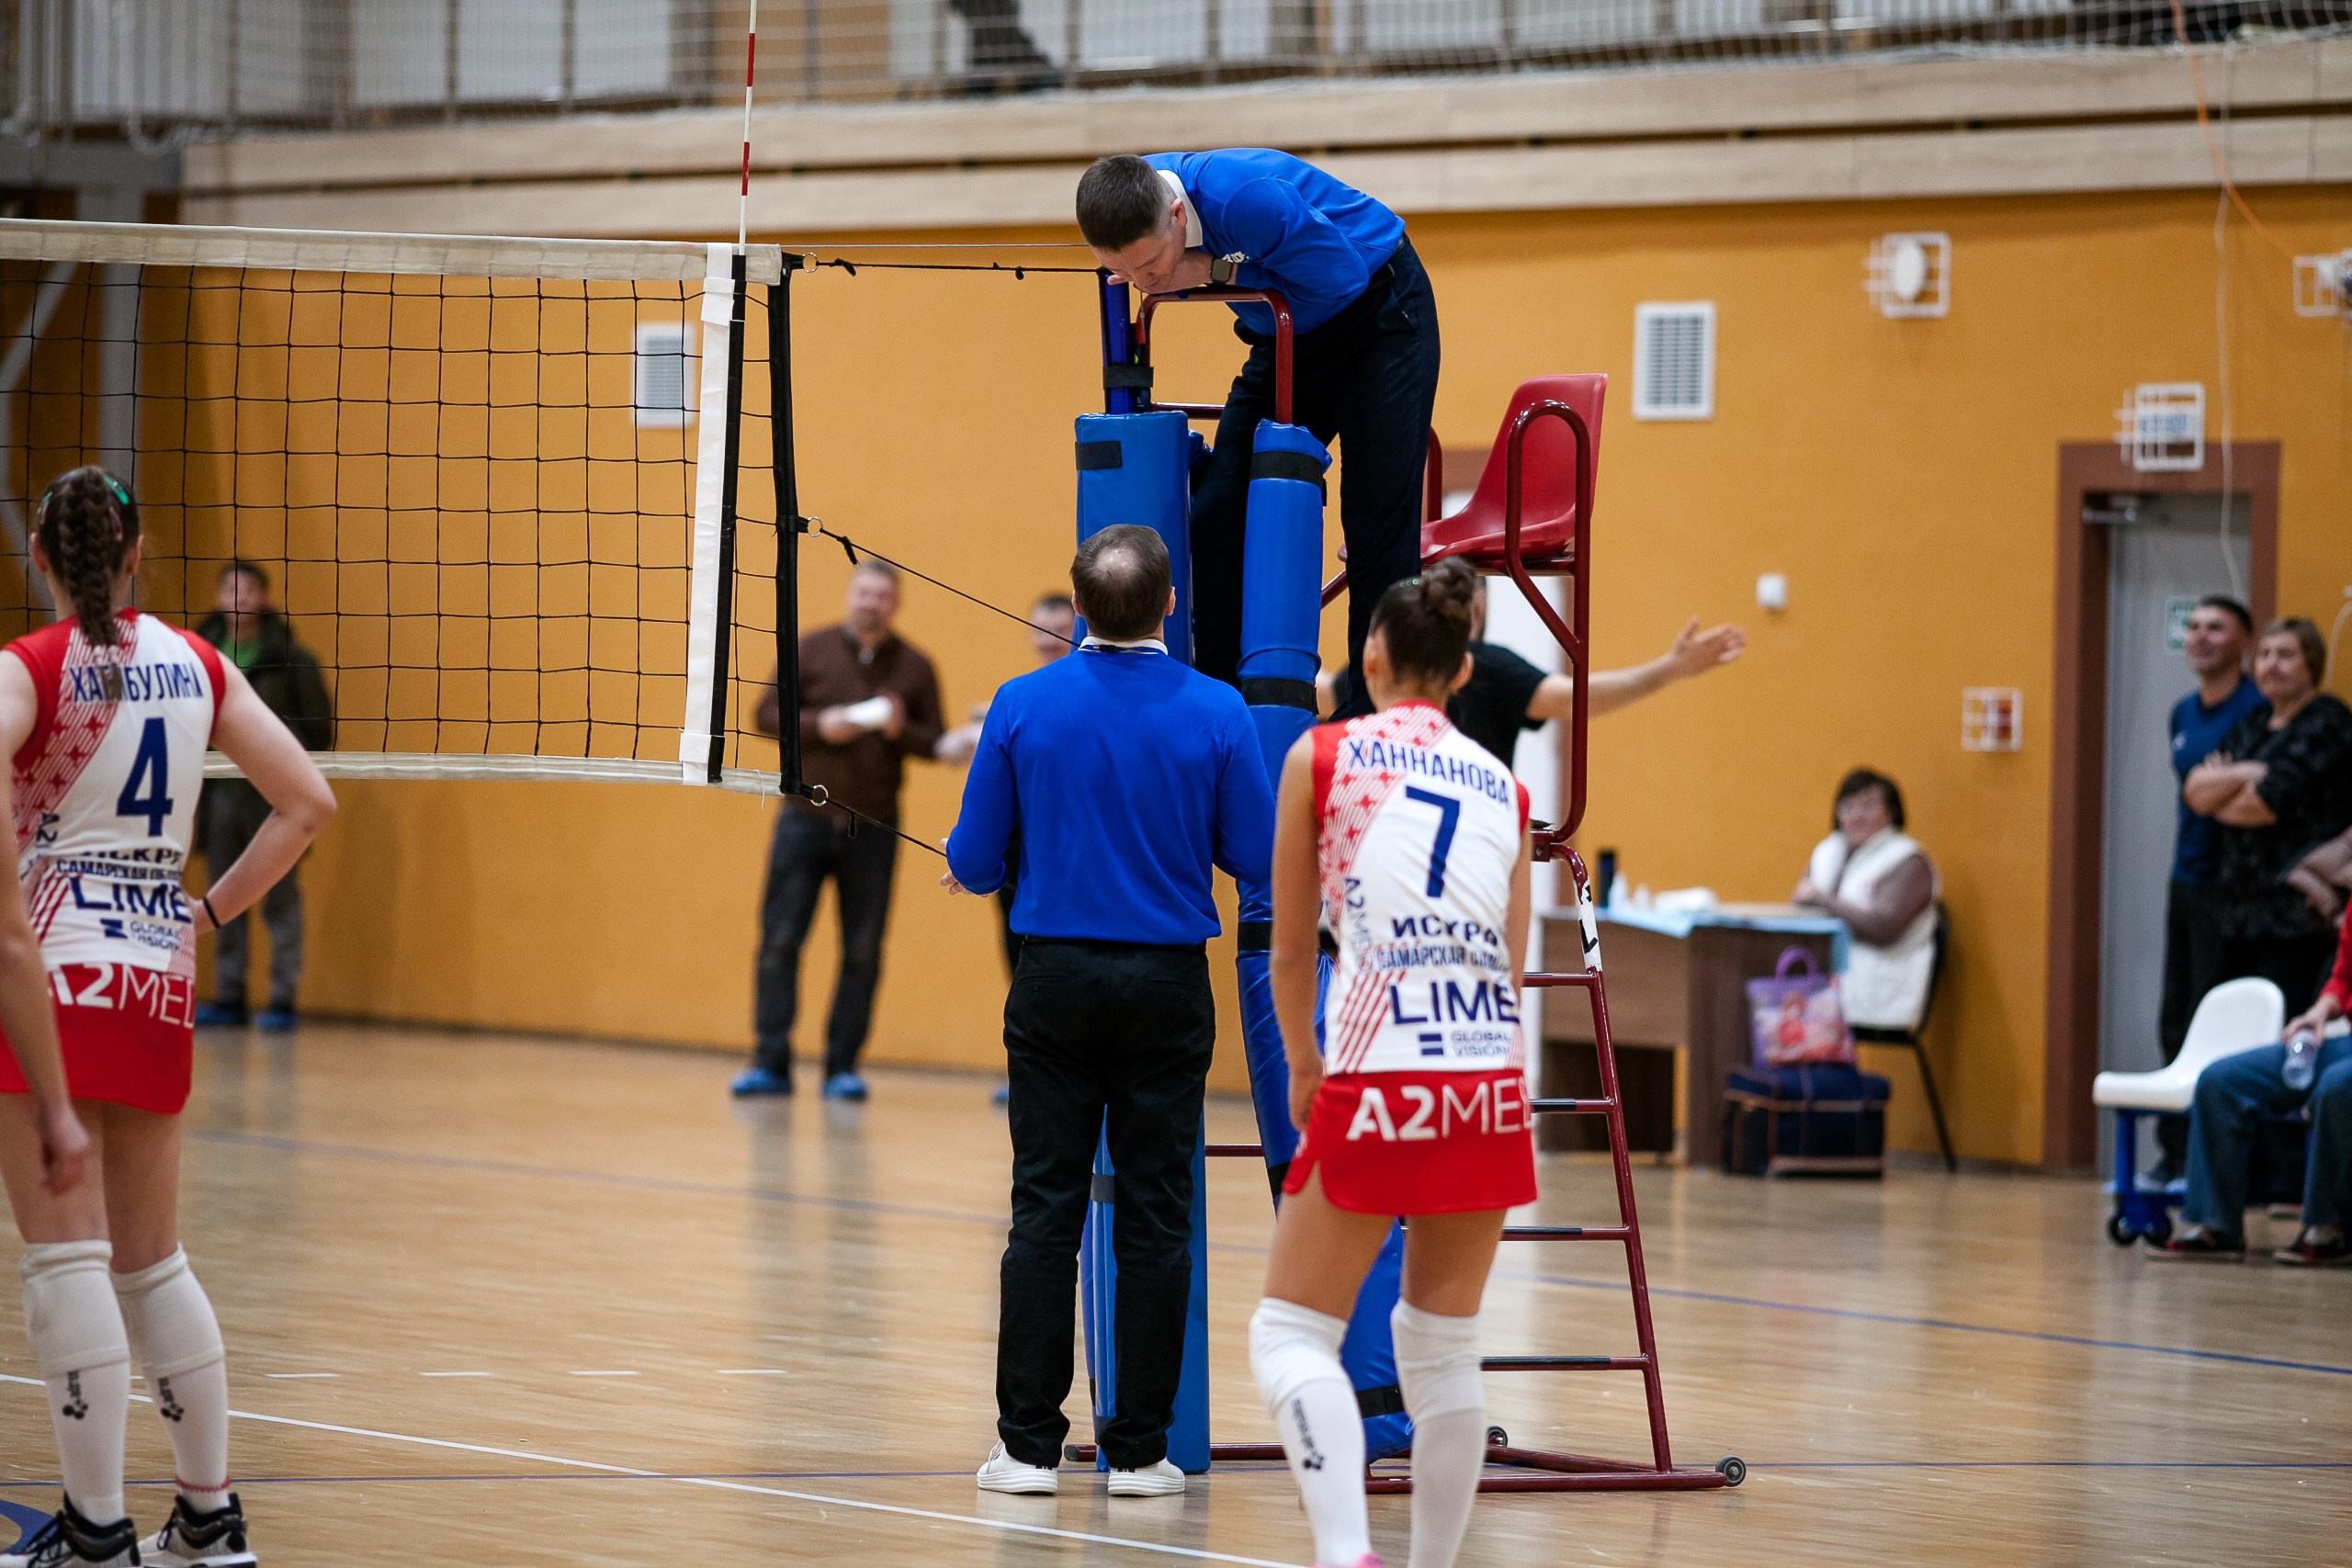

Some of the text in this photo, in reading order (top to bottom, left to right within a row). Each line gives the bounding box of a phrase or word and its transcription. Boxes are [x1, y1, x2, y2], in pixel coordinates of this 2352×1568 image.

[117, 717, 173, 837] 4
[1349, 739, 1510, 804] ХАННАНОВА
[1405, 785, 1461, 898] 7
[70, 876, 193, 924] LIME
[1389, 980, 1521, 1025] LIME
